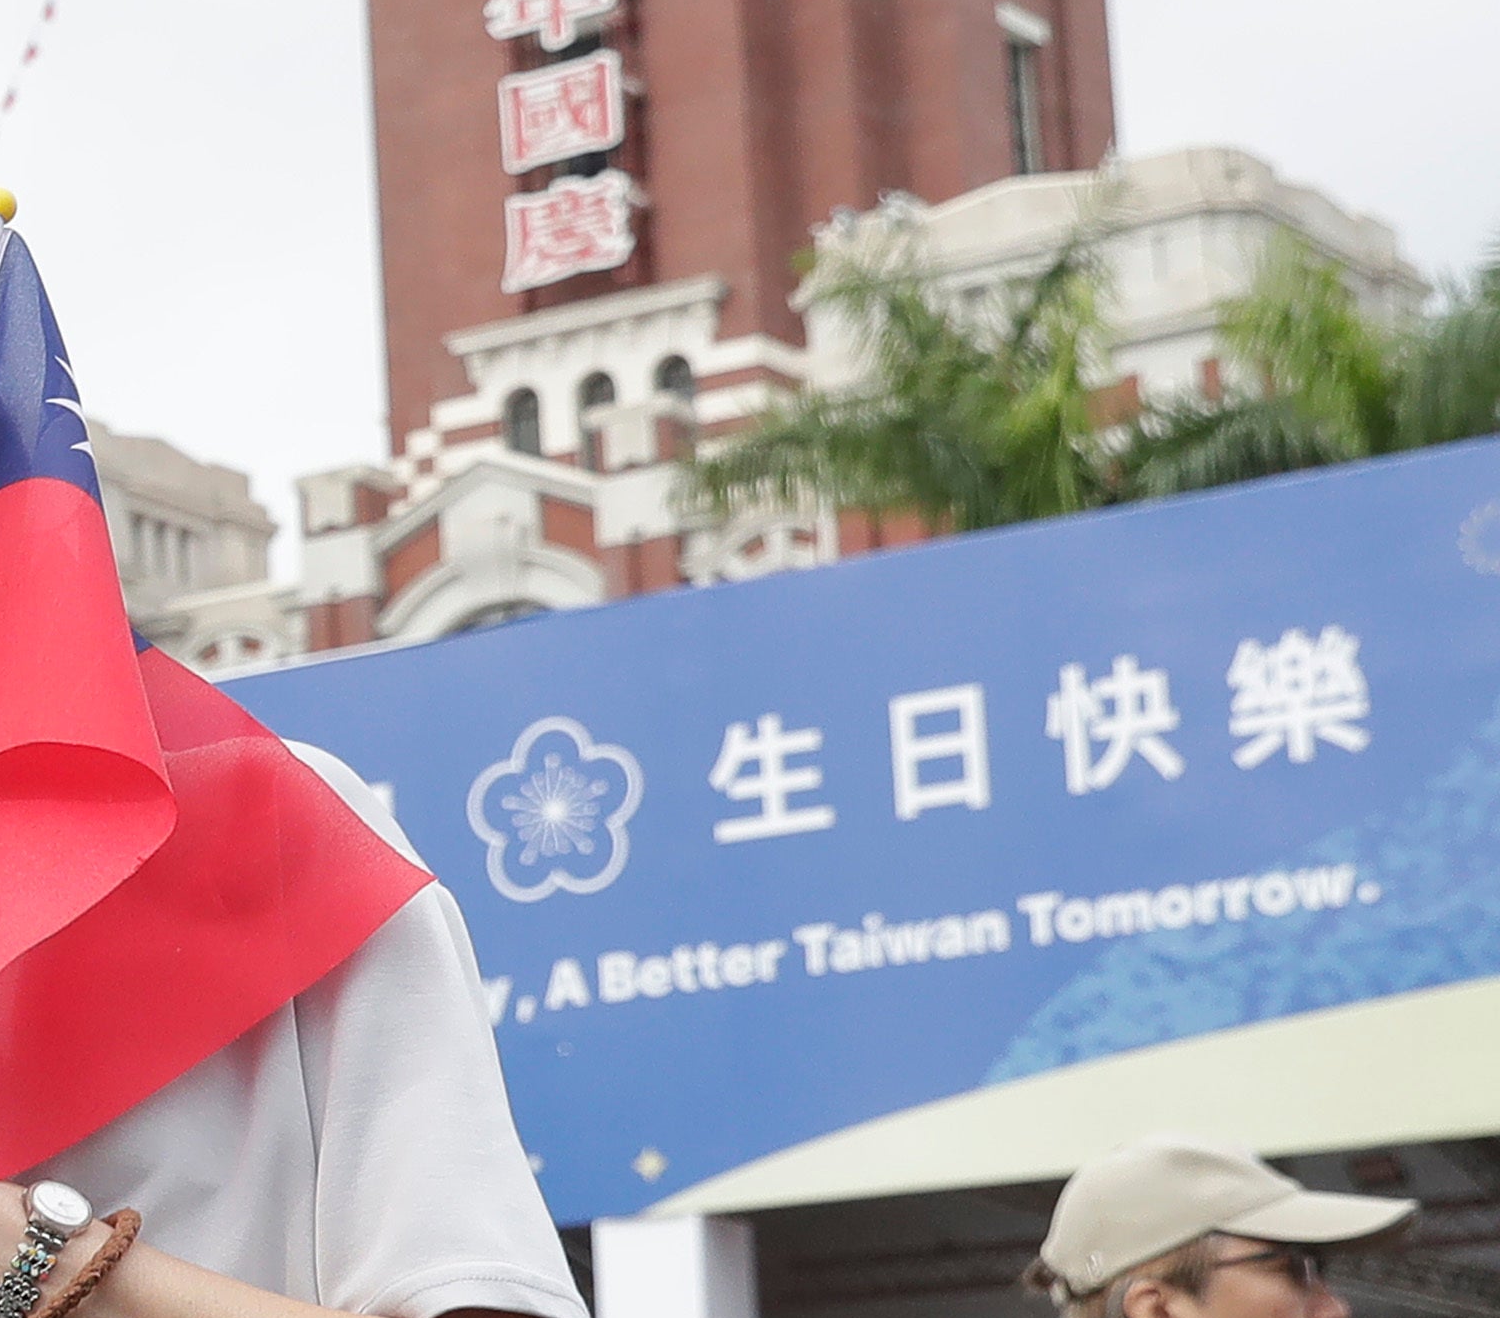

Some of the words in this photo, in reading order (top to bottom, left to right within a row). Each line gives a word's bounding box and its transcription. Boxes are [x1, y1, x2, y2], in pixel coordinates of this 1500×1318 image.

[708, 625, 1371, 845] 生日快樂
[545, 958, 591, 1011] A
[597, 939, 788, 1004] Better
[792, 910, 1012, 977] Taiwan
[1015, 862, 1382, 947] Tomorrow.
